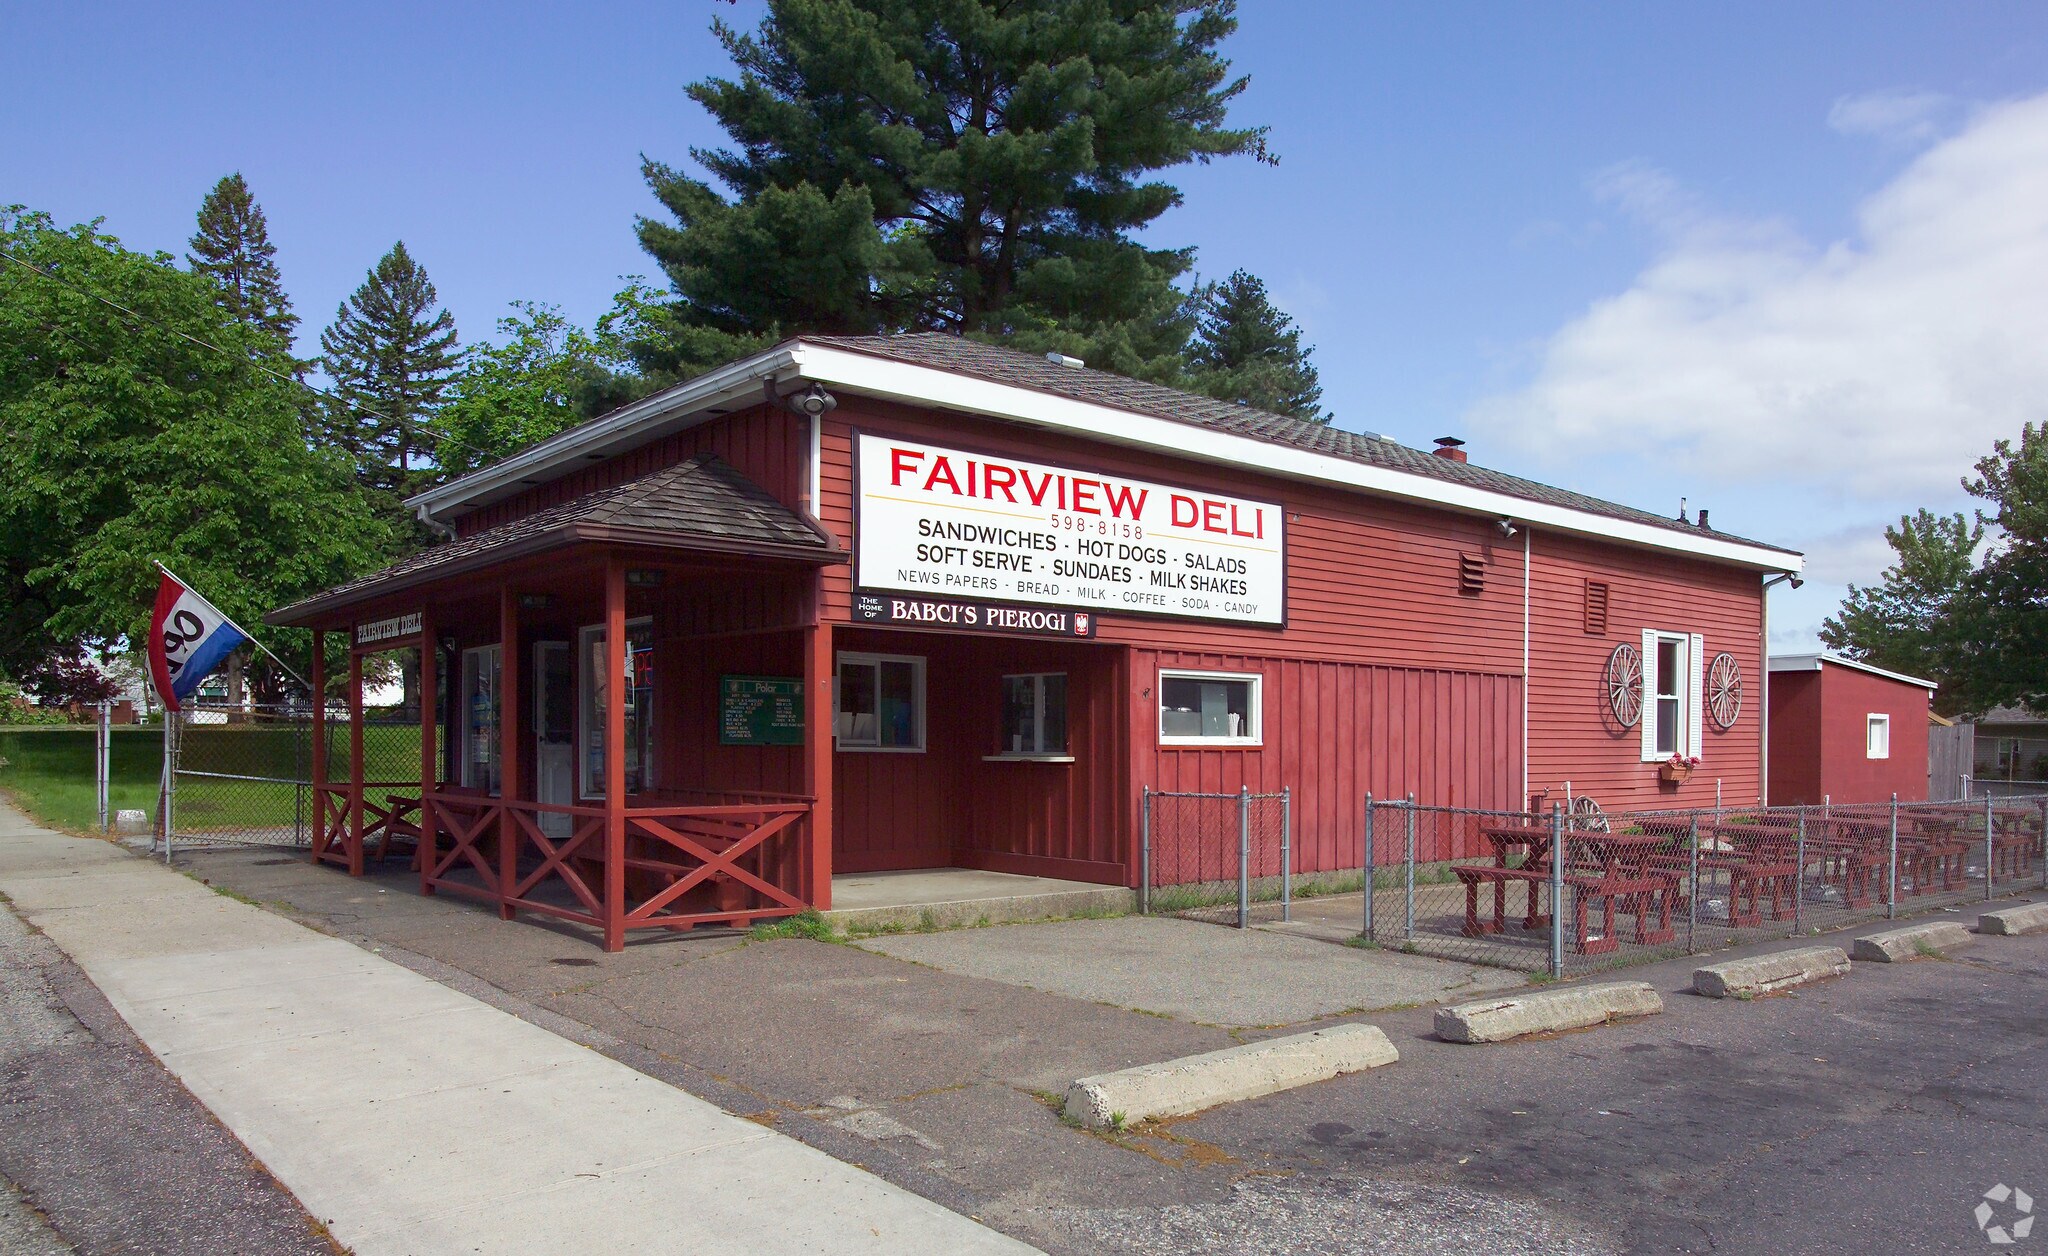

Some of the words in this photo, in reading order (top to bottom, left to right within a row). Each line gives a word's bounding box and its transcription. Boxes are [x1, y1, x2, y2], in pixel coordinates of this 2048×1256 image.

[890, 448, 1149, 521] FAIRVIEW
[1170, 494, 1263, 539] DELI
[1052, 514, 1142, 539] 598-8158
[919, 518, 1056, 551] SANDWICHES
[1078, 539, 1114, 558] HOT
[1119, 544, 1166, 564] DOGS
[1186, 553, 1246, 574] SALADS
[917, 544, 968, 565] SOFT
[973, 550, 1032, 572] SERVE
[1053, 559, 1131, 583] SUNDAES
[1151, 570, 1186, 589] MILK
[1190, 575, 1246, 595] SHAKES
[859, 603, 883, 611] HOME
[898, 570, 939, 584] NEWS
[946, 574, 997, 589] PAPERS
[1018, 581, 1059, 595] BREAD
[1078, 587, 1105, 599] MILK
[1123, 592, 1165, 605] COFFEE
[1182, 598, 1209, 609] SODA
[1225, 602, 1257, 614] CANDY
[357, 617, 400, 643] FAIRVIEW
[401, 612, 422, 635] DELI
[892, 600, 977, 624] BABCI'S
[986, 608, 1066, 630] PIEROGI
[755, 683, 777, 693] Polar
